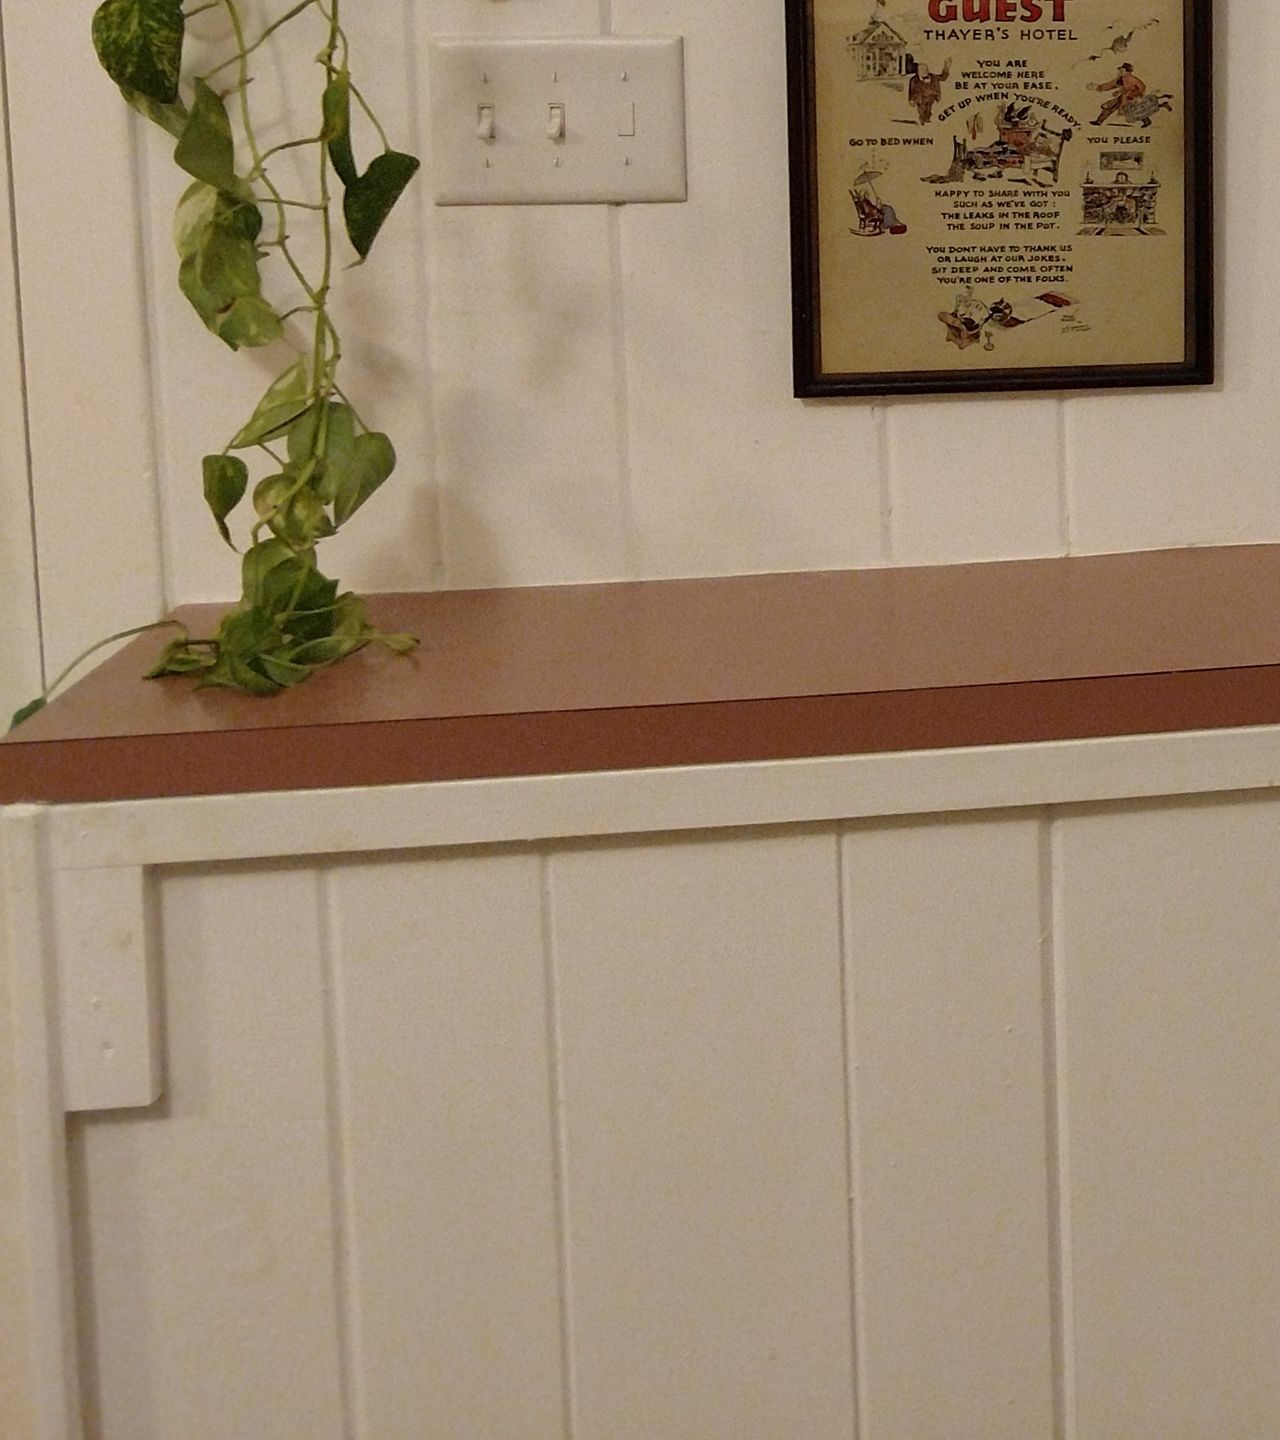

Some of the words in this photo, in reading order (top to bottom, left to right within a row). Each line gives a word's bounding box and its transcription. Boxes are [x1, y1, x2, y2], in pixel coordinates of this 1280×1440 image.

[923, 27, 1010, 41] THAYER'S
[1020, 29, 1078, 41] HOTEL
[976, 60, 1000, 68] YOU
[1006, 60, 1028, 68] ARE
[961, 71, 1013, 79] WELCOME
[1017, 71, 1045, 79] HERE
[955, 82, 969, 90] BE
[973, 82, 987, 90] AT
[991, 82, 1019, 90] YOUR
[938, 106, 955, 122] GET
[958, 98, 972, 109] UP
[975, 92, 1009, 103] WHEN
[1013, 93, 1050, 109] YOU'RE
[849, 138, 864, 147] GO
[866, 138, 879, 146] TO
[880, 138, 900, 146] BED
[902, 137, 934, 146] WHEN
[1087, 136, 1108, 144] YOU
[1113, 136, 1151, 144] PLEASE
[996, 200, 1026, 208] WE'VE
[941, 212, 960, 220] THE
[1033, 211, 1060, 219] ROOF
[970, 222, 996, 230] SOUP
[1014, 222, 1033, 230] THE
[926, 246, 946, 254] YOU
[954, 255, 987, 263] LAUGH
[932, 266, 947, 274] SIT
[951, 266, 979, 274] DEEP
[1040, 265, 1073, 273] OFTEN
[937, 276, 972, 284] YOU'RE
